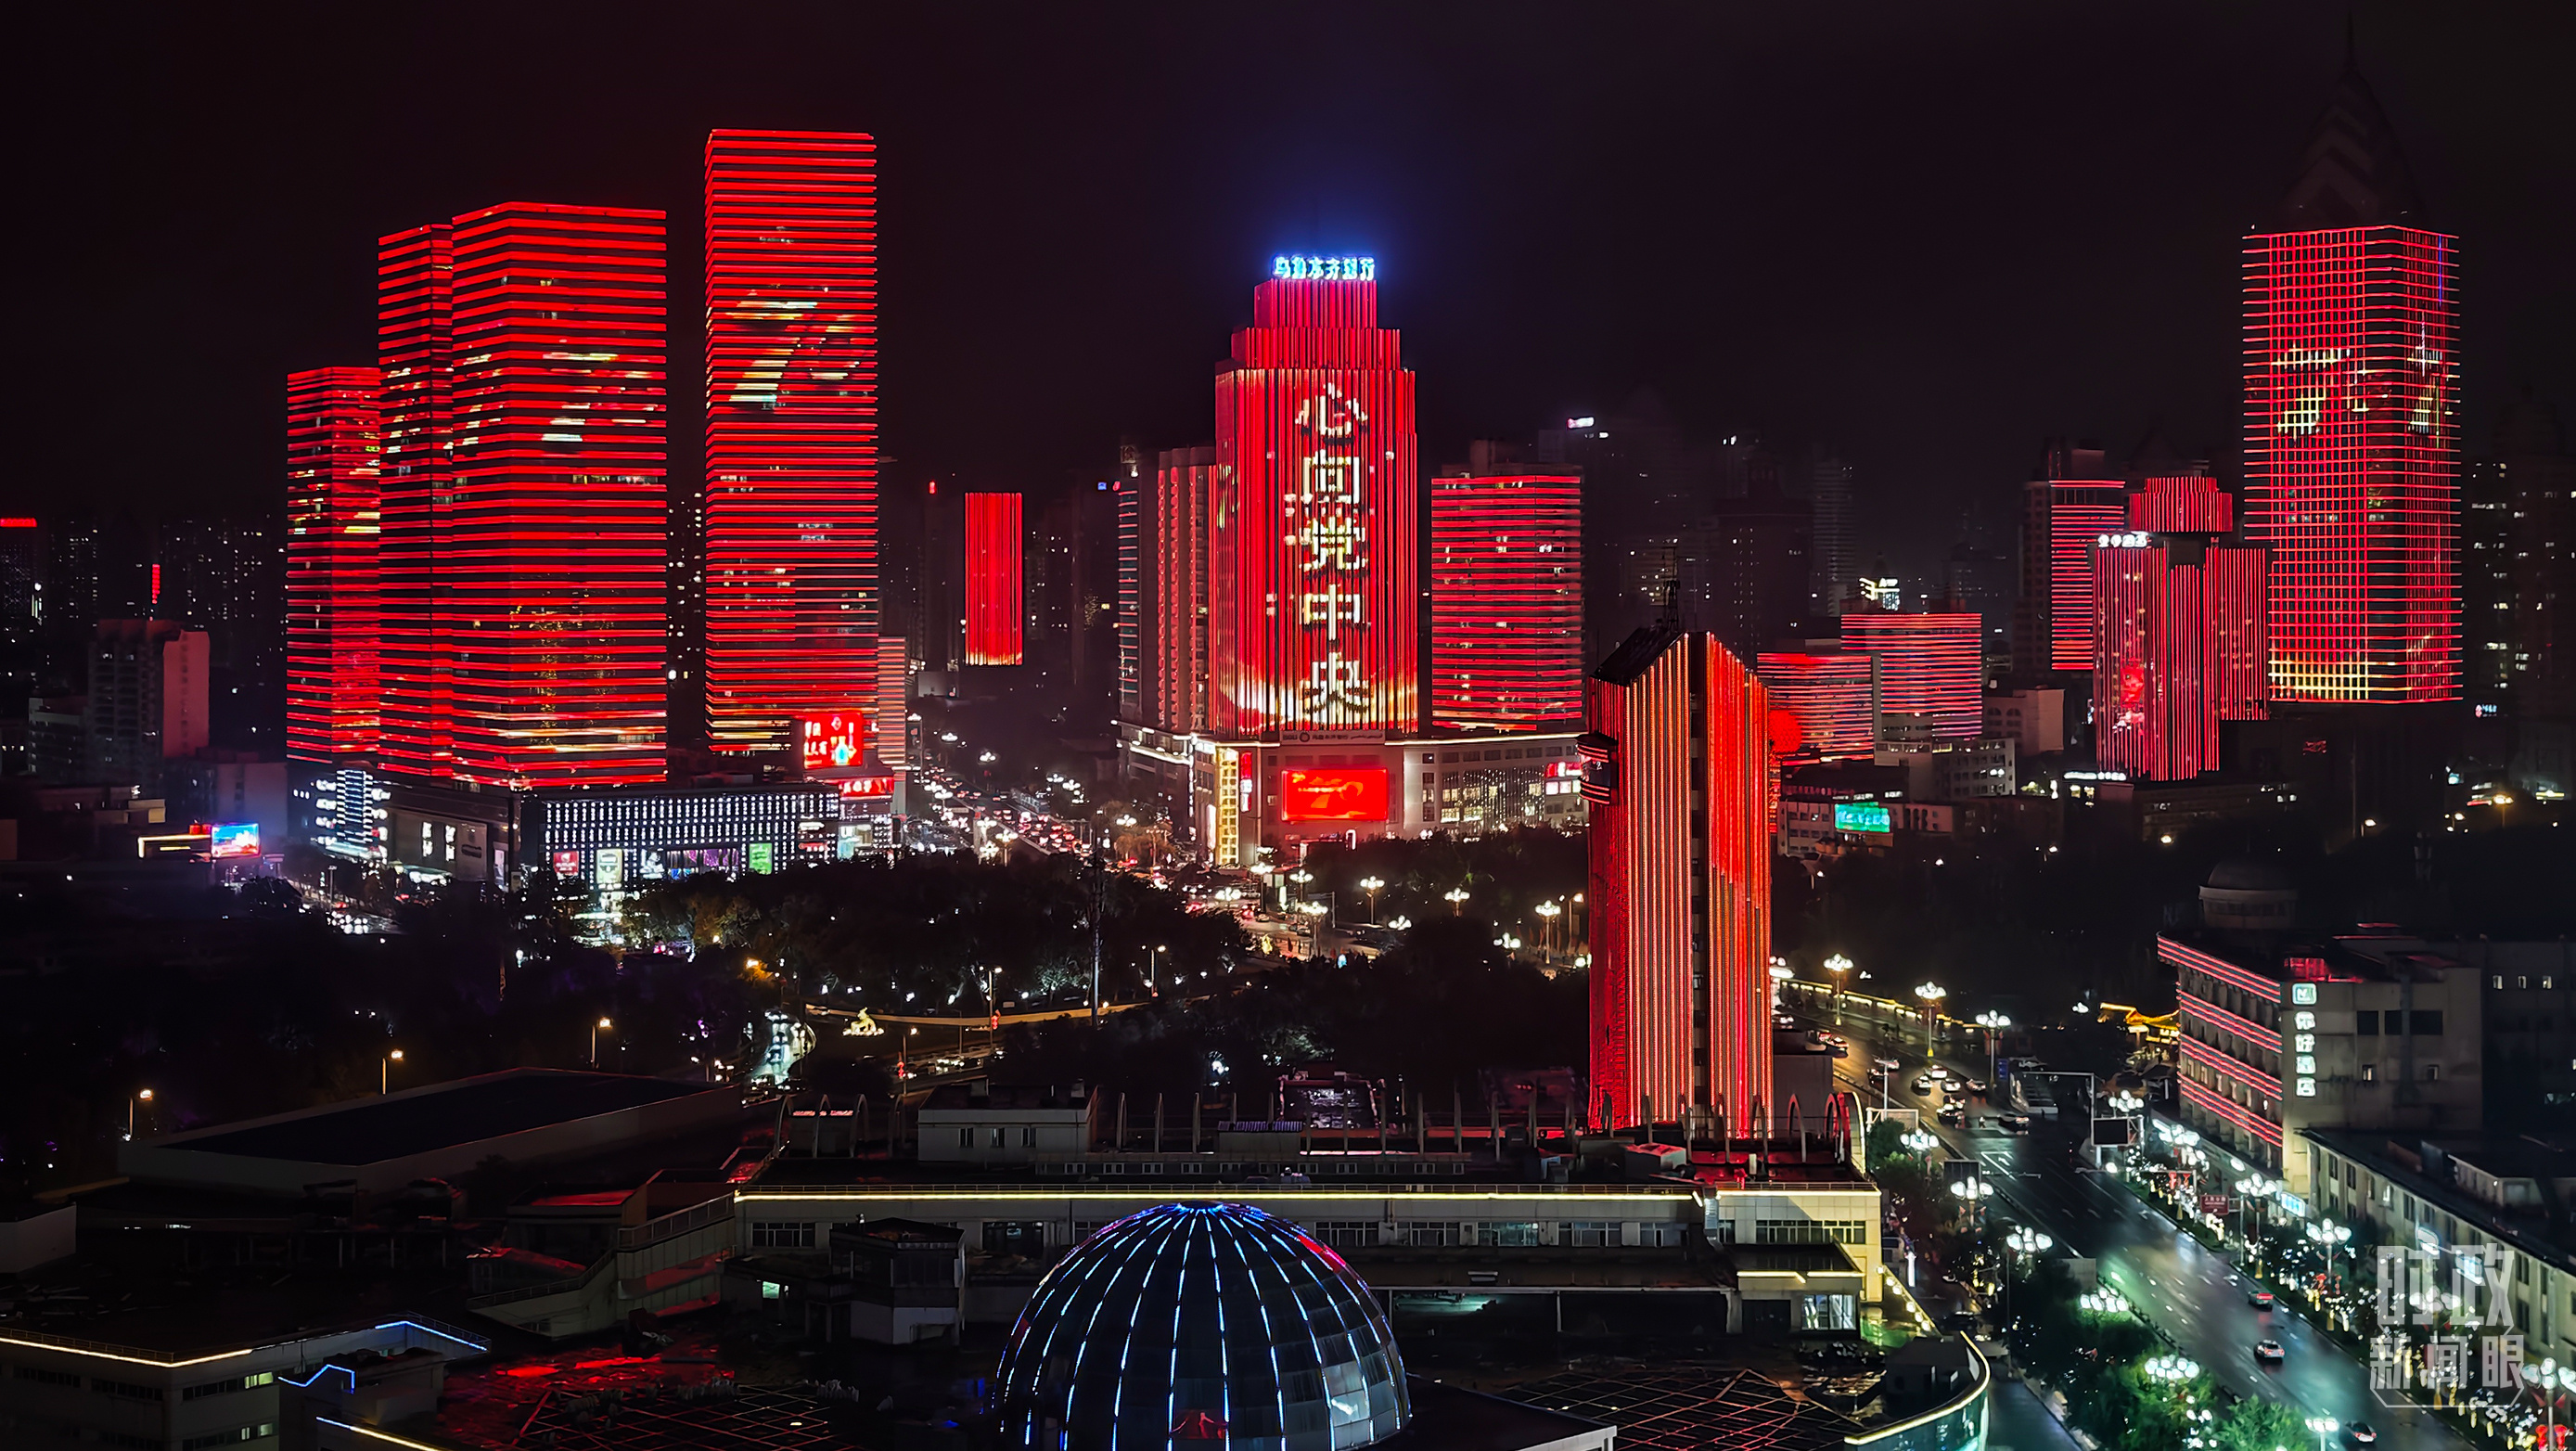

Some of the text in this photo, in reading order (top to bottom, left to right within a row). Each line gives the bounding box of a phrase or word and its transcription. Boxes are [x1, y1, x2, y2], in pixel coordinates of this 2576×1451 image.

[1295, 381, 1369, 723] 心向党中央
